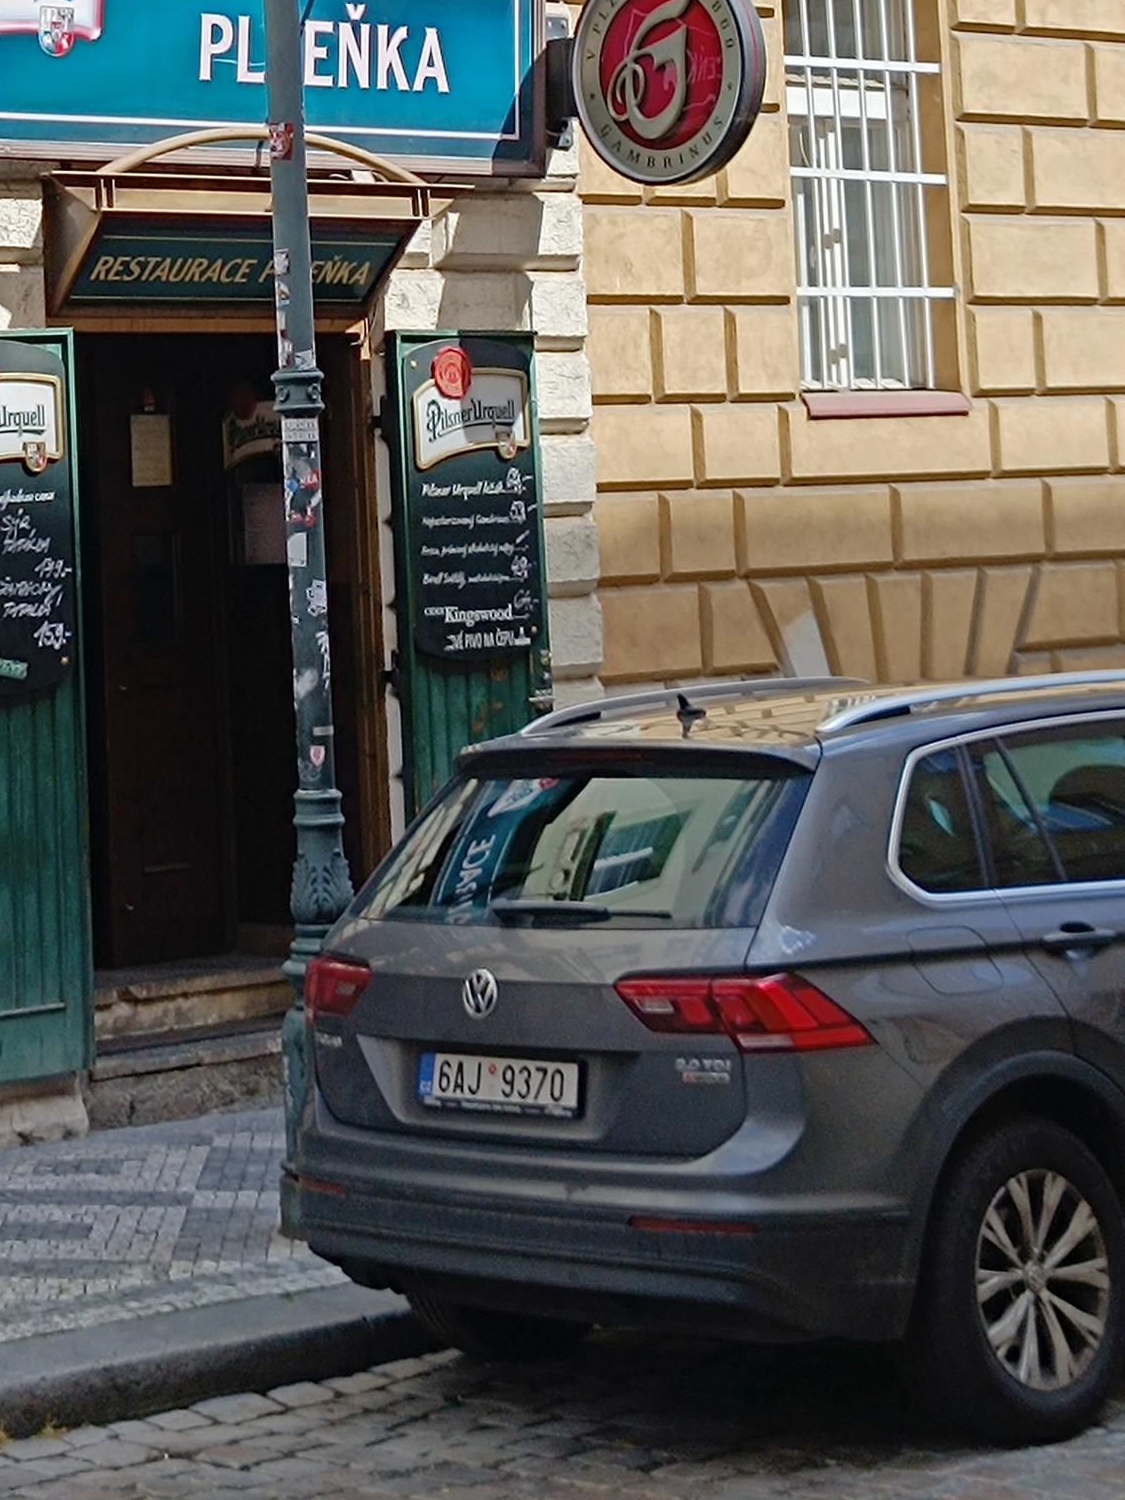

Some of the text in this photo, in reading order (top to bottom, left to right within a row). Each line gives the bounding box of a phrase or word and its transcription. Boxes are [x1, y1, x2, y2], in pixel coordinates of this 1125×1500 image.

[198, 3, 450, 93] PLEŇKA
[600, 115, 724, 169] GAMBRINUS
[90, 256, 257, 283] RESTAURACE
[426, 398, 515, 443] Pilsner Urquell
[444, 603, 514, 628] Kingswood
[438, 1060, 565, 1102] 6AJ 9370
